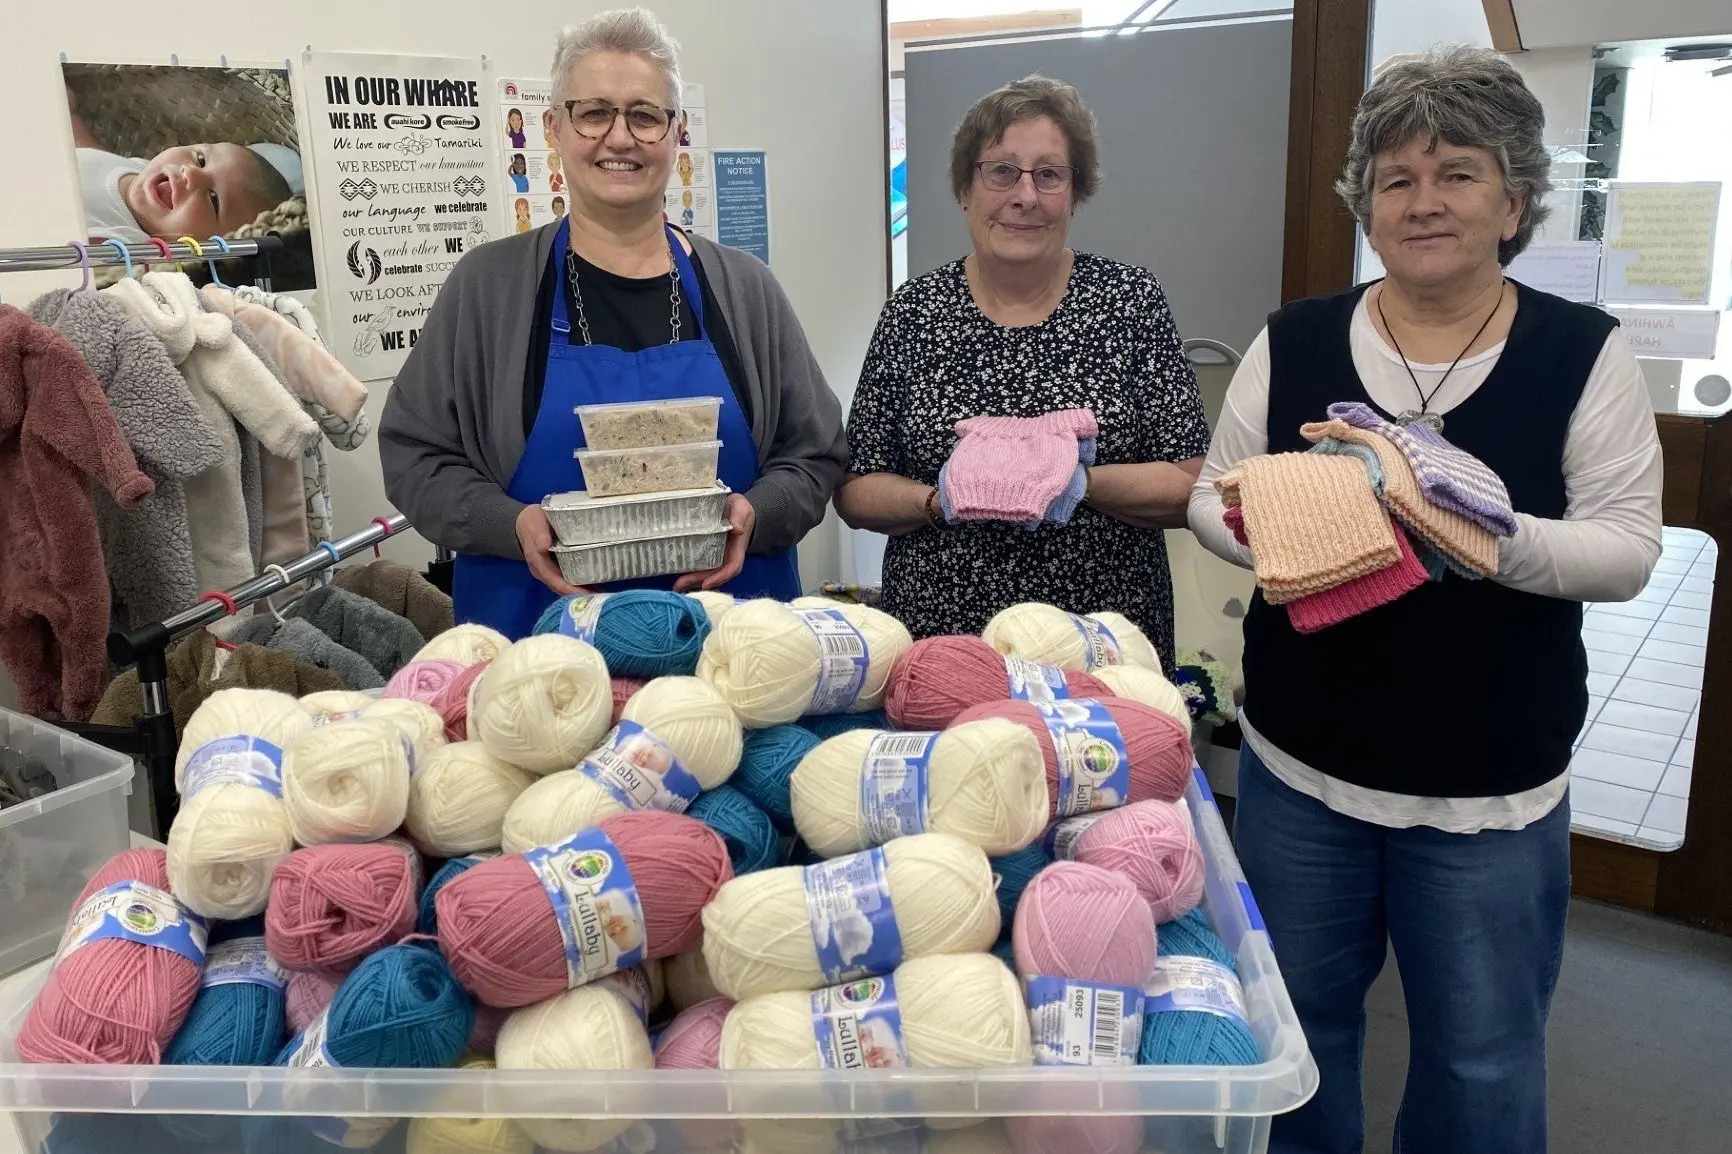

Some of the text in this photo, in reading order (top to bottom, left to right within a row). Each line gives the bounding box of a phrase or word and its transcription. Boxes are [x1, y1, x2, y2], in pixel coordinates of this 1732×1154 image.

[325, 76, 479, 107] IN OUR WHARE
[328, 112, 351, 130] WE
[353, 113, 378, 130] ARE
[409, 117, 425, 125] kore
[442, 118, 475, 126] smokefree
[333, 137, 483, 150] We love our Tamariki
[336, 160, 360, 173] WE
[362, 160, 417, 173] RESPECT
[419, 161, 435, 170] our
[718, 156, 761, 165] FIRE ACTION
[727, 167, 753, 175] NOTICE
[379, 181, 451, 195] WE CHERISH
[343, 201, 487, 222] our language we celebrate
[343, 221, 468, 237] OUR CULTURE WE SUPPORT
[383, 237, 464, 258] each other WE
[384, 263, 423, 276] celebrate
[349, 289, 374, 303] WE
[376, 286, 415, 301] LOOK
[352, 312, 374, 324] our
[380, 330, 405, 351] WE
[597, 750, 642, 792] Lullaby
[575, 891, 601, 956] Lullaby
[1074, 988, 1085, 1019] 25093
[1072, 1044, 1082, 1057] 93
